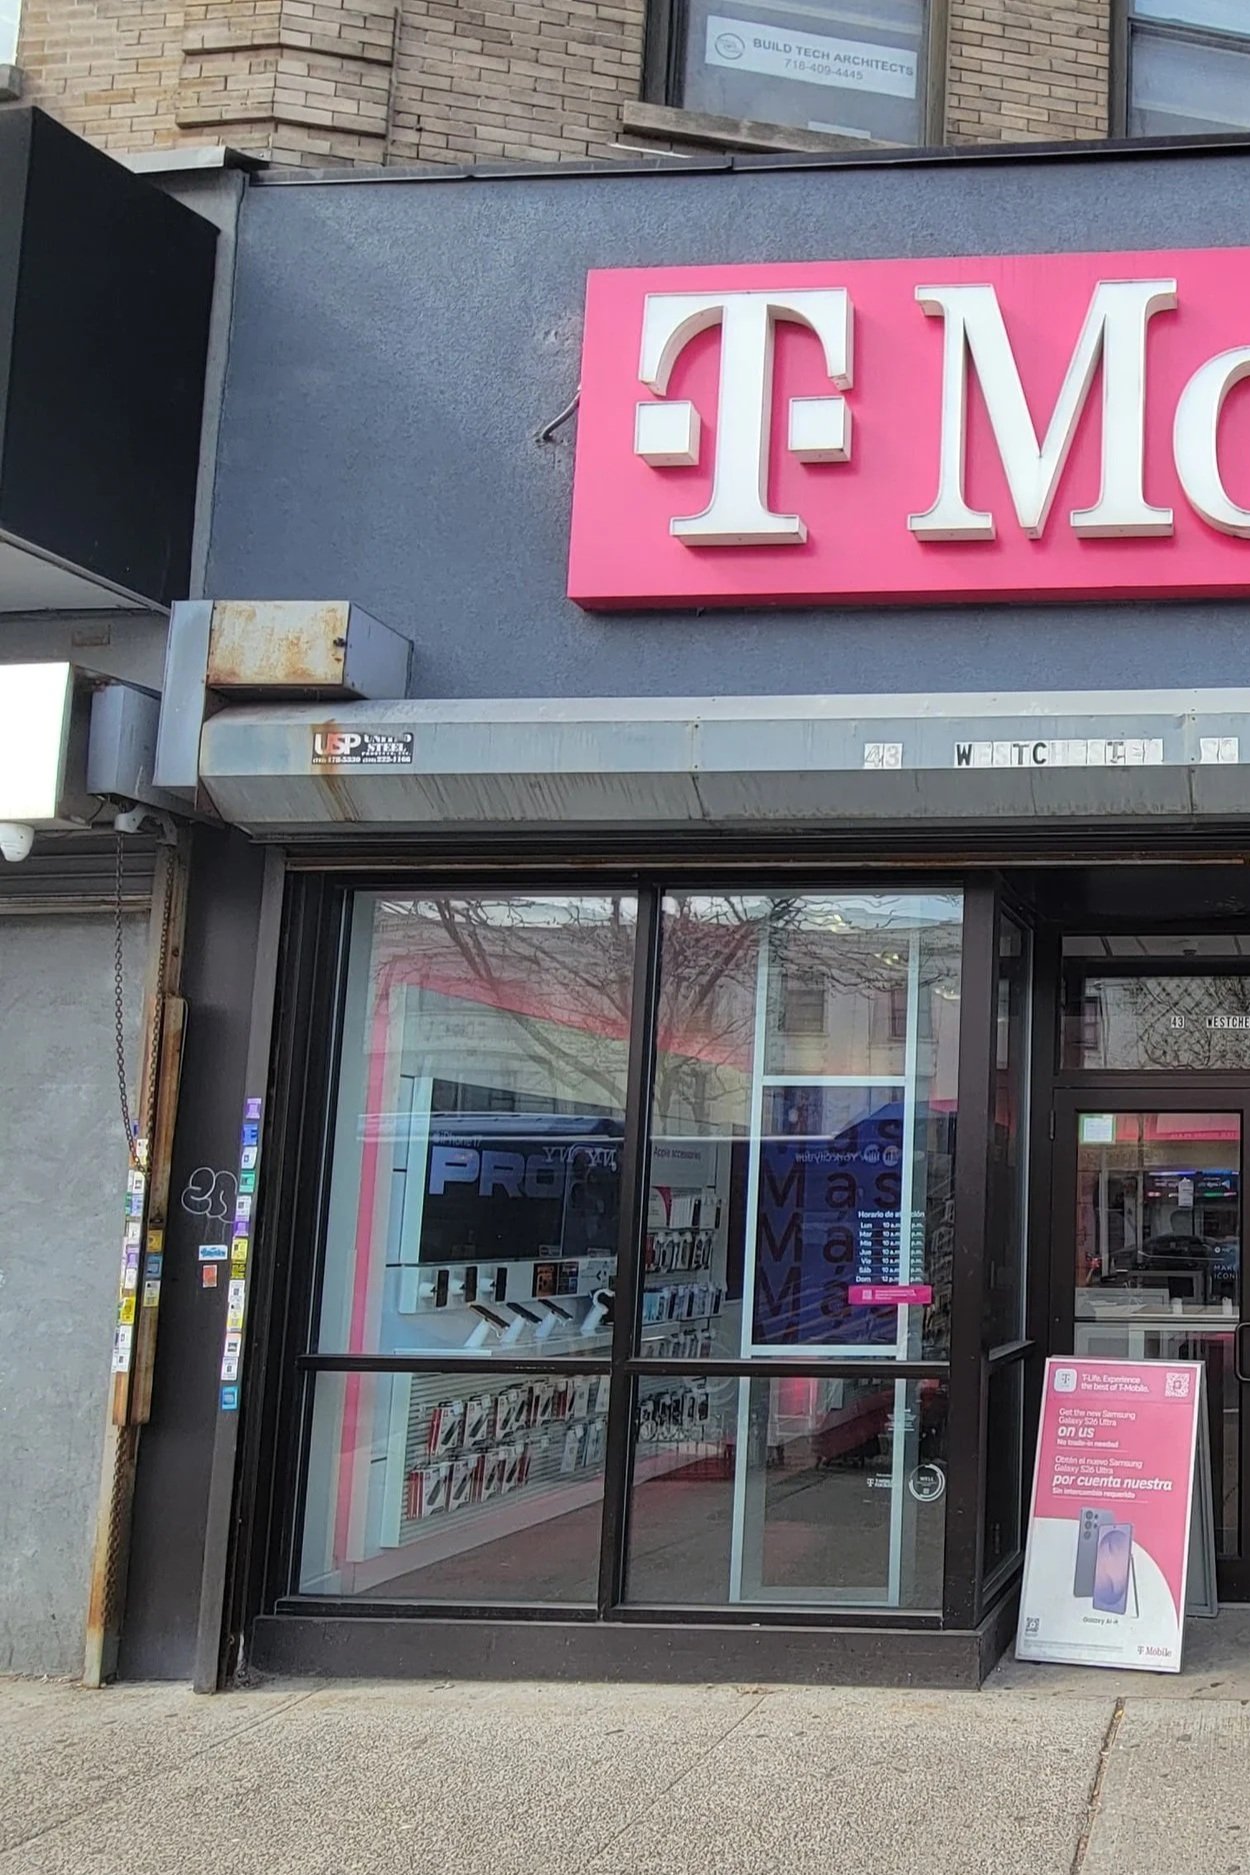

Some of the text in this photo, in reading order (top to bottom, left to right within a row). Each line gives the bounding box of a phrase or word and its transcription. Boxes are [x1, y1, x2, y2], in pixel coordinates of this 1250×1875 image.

[753, 38, 792, 54] BUILD
[797, 46, 830, 61] TECH
[834, 53, 914, 77] ARCHITECTS
[634, 288, 852, 545] T
[364, 733, 412, 743] UNITD
[1171, 1016, 1184, 1028] 43
[429, 1145, 567, 1198] PRO
[1103, 1375, 1141, 1384] Experience
[1081, 1382, 1093, 1391] the
[1093, 1383, 1109, 1391] best
[1110, 1383, 1118, 1391] of
[1059, 1408, 1073, 1417] Get
[1074, 1408, 1085, 1417] the
[1102, 1410, 1136, 1420] Samsung
[1058, 1416, 1117, 1427] Galaxy S26 Ultra
[1058, 1427, 1095, 1438] on us
[1094, 1440, 1119, 1448] needed
[1079, 1457, 1085, 1465] el
[1109, 1458, 1143, 1469] Samsung
[1054, 1464, 1079, 1474] Galaxy
[1095, 1466, 1114, 1475] Ultra
[1052, 1475, 1172, 1491] por cuenta nuestra
[1063, 1488, 1102, 1497] intercambio
[1103, 1491, 1136, 1499] requerido
[1145, 1647, 1172, 1657] Mobile
